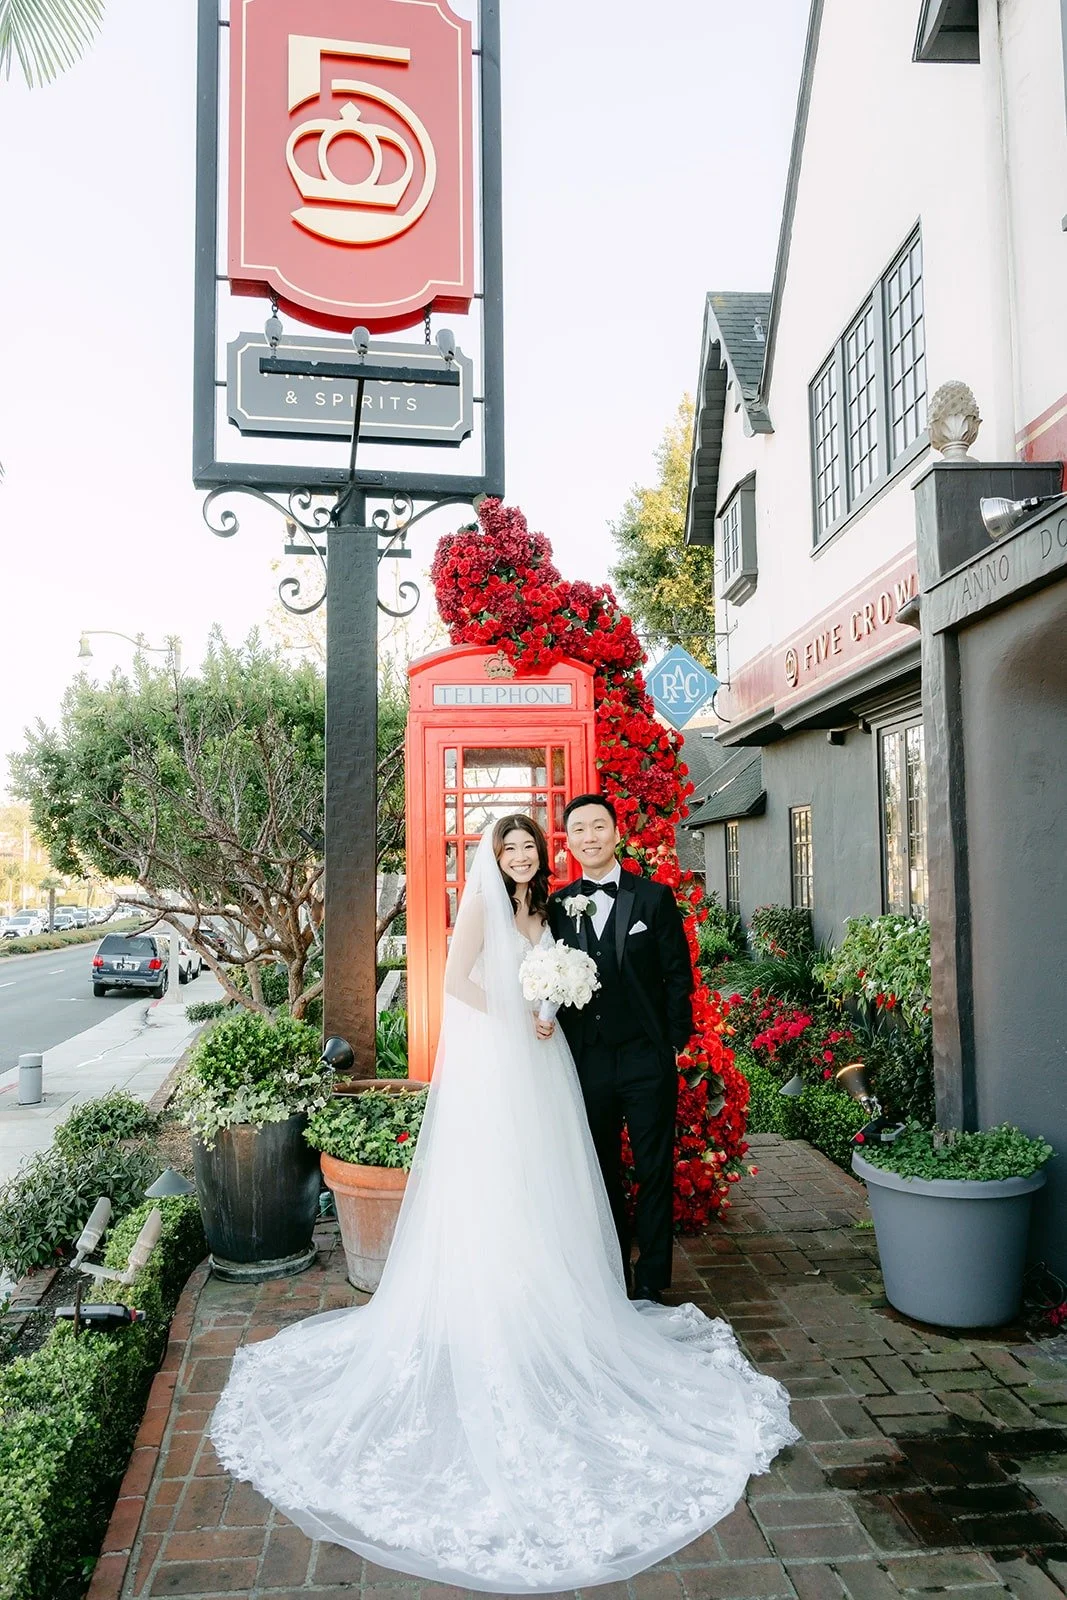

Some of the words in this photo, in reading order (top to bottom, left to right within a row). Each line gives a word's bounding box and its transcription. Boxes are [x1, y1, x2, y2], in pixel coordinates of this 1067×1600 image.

[285, 390, 298, 405] &
[315, 392, 418, 411] SPIRITS
[962, 554, 1010, 603] ANNO
[803, 625, 843, 671] FIVE
[849, 572, 919, 642] CROW
[439, 687, 568, 704] TELEPHONE
[661, 664, 700, 704] RAC
